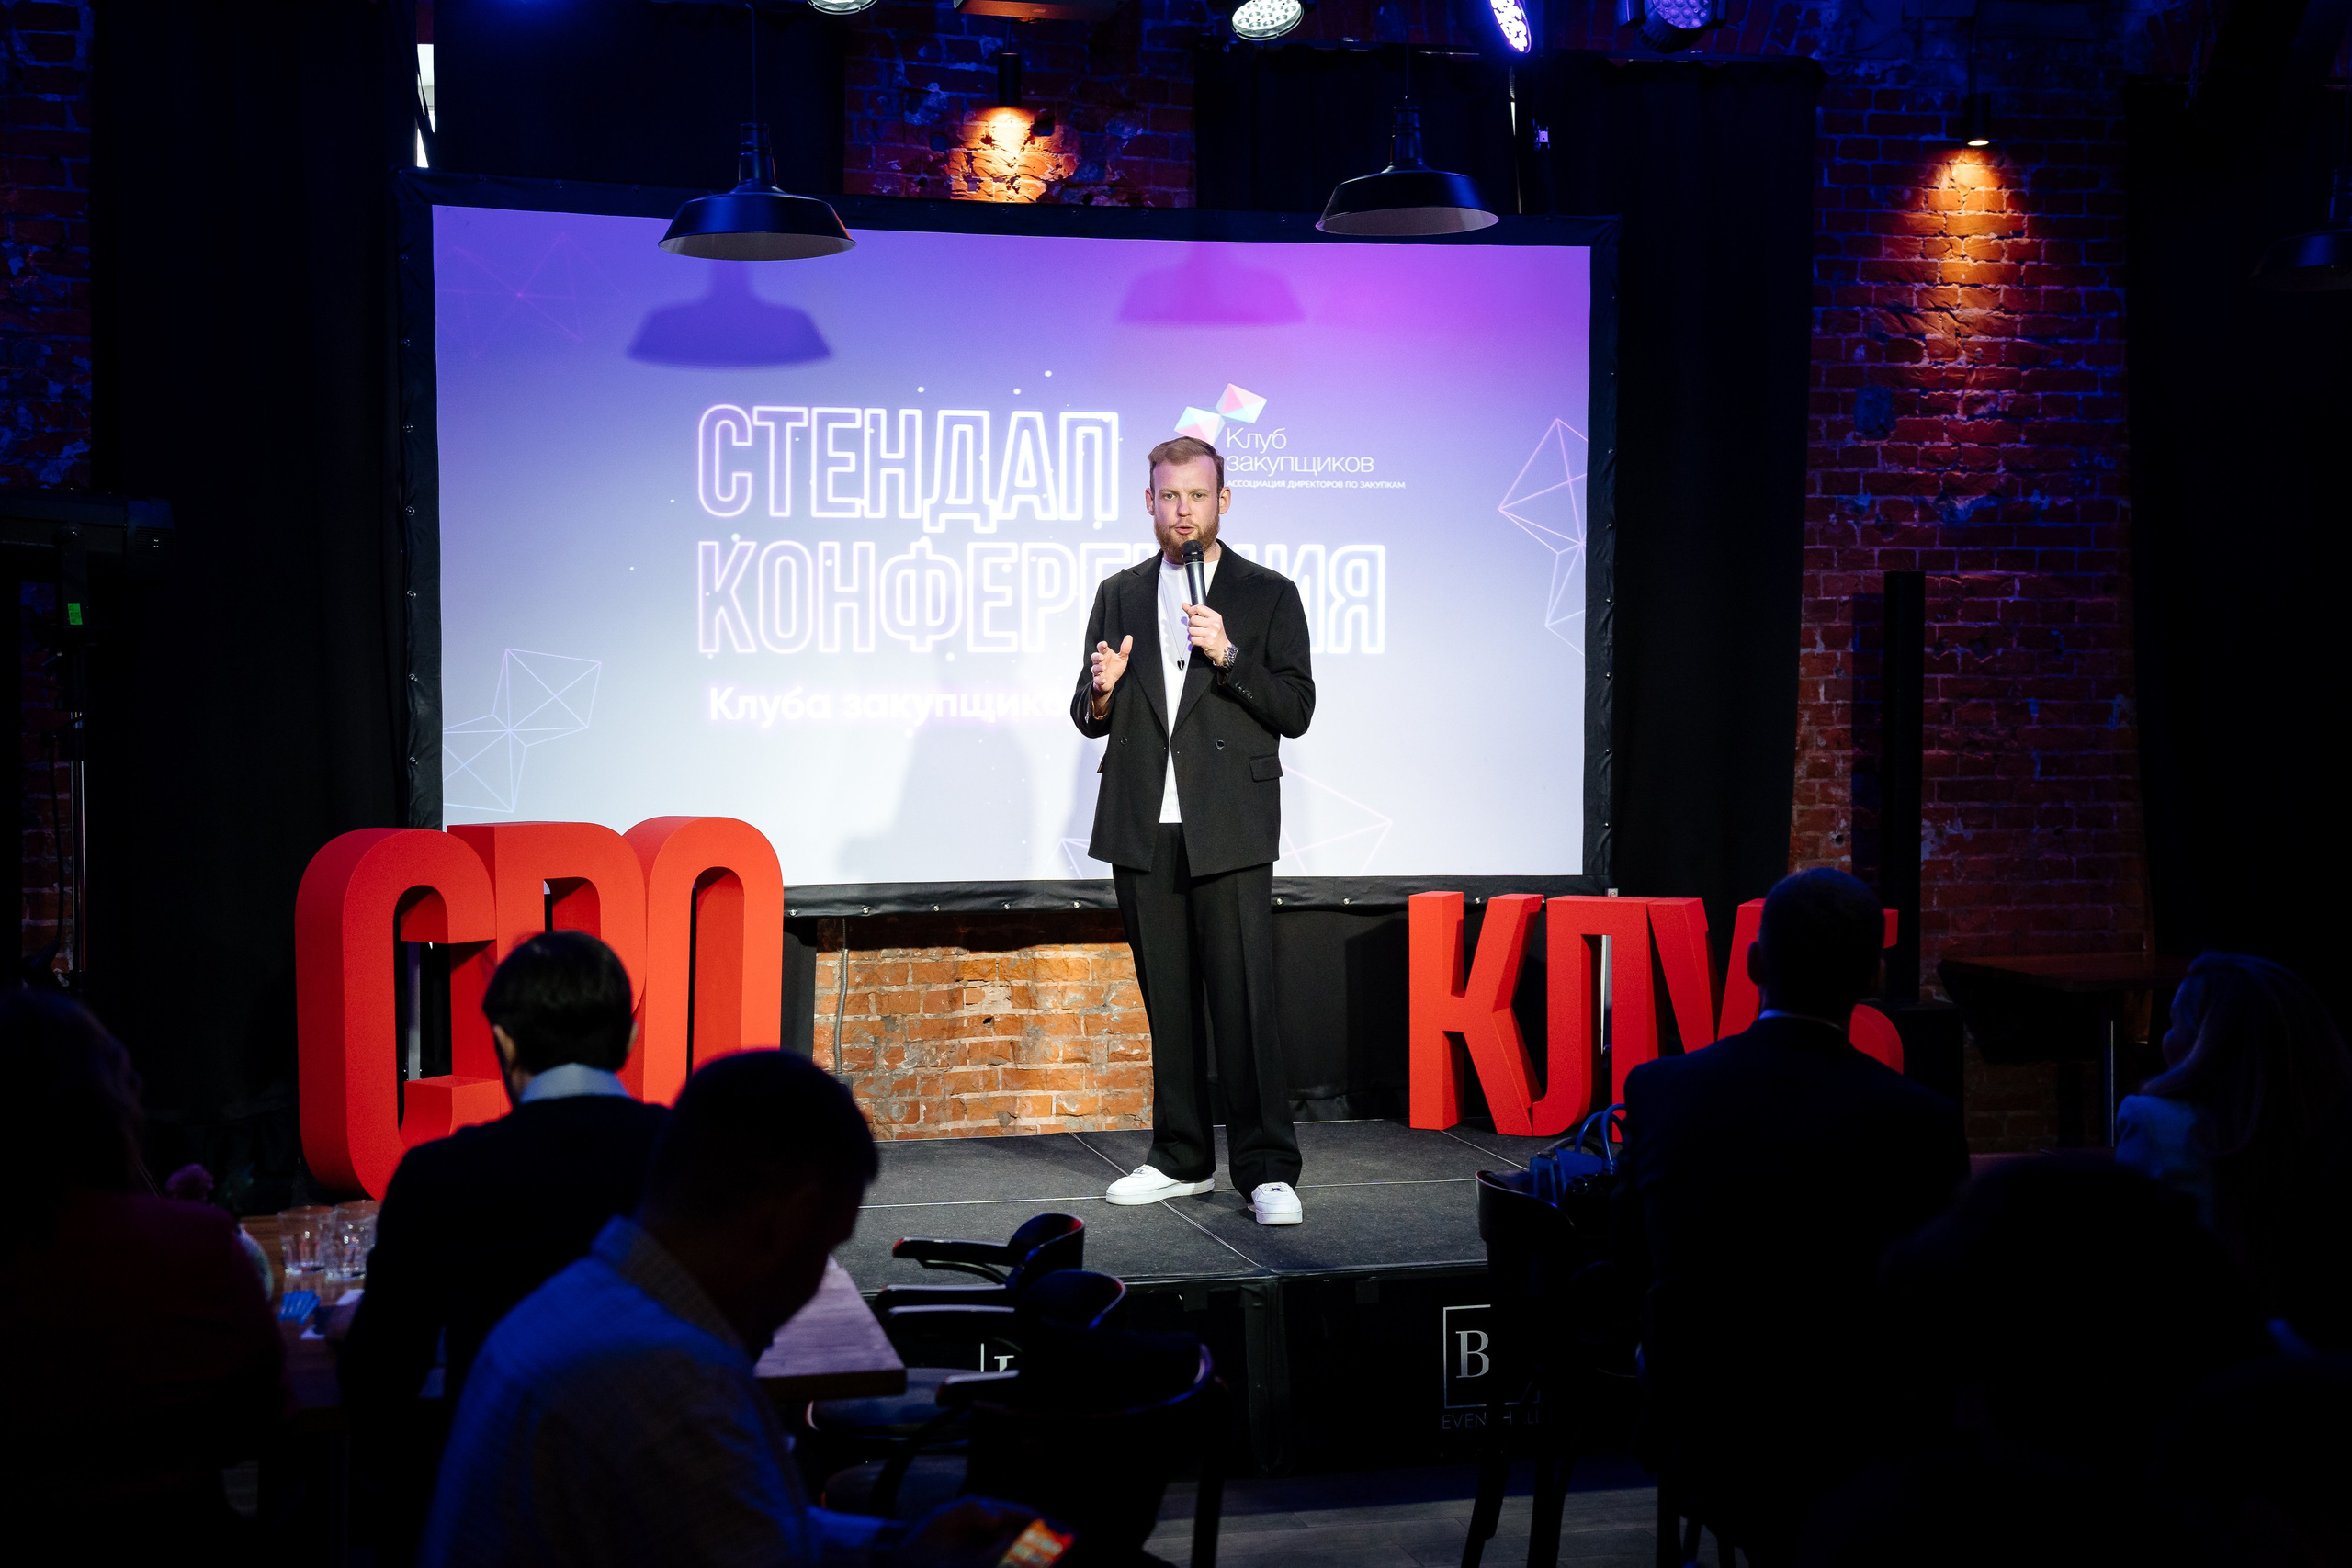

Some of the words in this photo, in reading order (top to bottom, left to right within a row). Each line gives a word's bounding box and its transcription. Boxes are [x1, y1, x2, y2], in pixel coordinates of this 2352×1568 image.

[1226, 427, 1287, 454] Клуб
[698, 402, 1120, 534] СТЕНДАП
[1226, 455, 1374, 477] закупщиков
[1227, 479, 1286, 489] АССОЦИАЦИЯ
[1287, 480, 1343, 490] ДИРЕКТОРОВ
[1345, 480, 1358, 489] ПО
[1360, 480, 1406, 490] ЗАКУПКАМ
[698, 537, 1386, 655] КОНФЕРИЯ
[709, 685, 831, 728] Клуба
[842, 691, 1070, 724] закупщико
[1408, 890, 1904, 1143] КЛУ
[1442, 1412, 1487, 1430] EVEN
